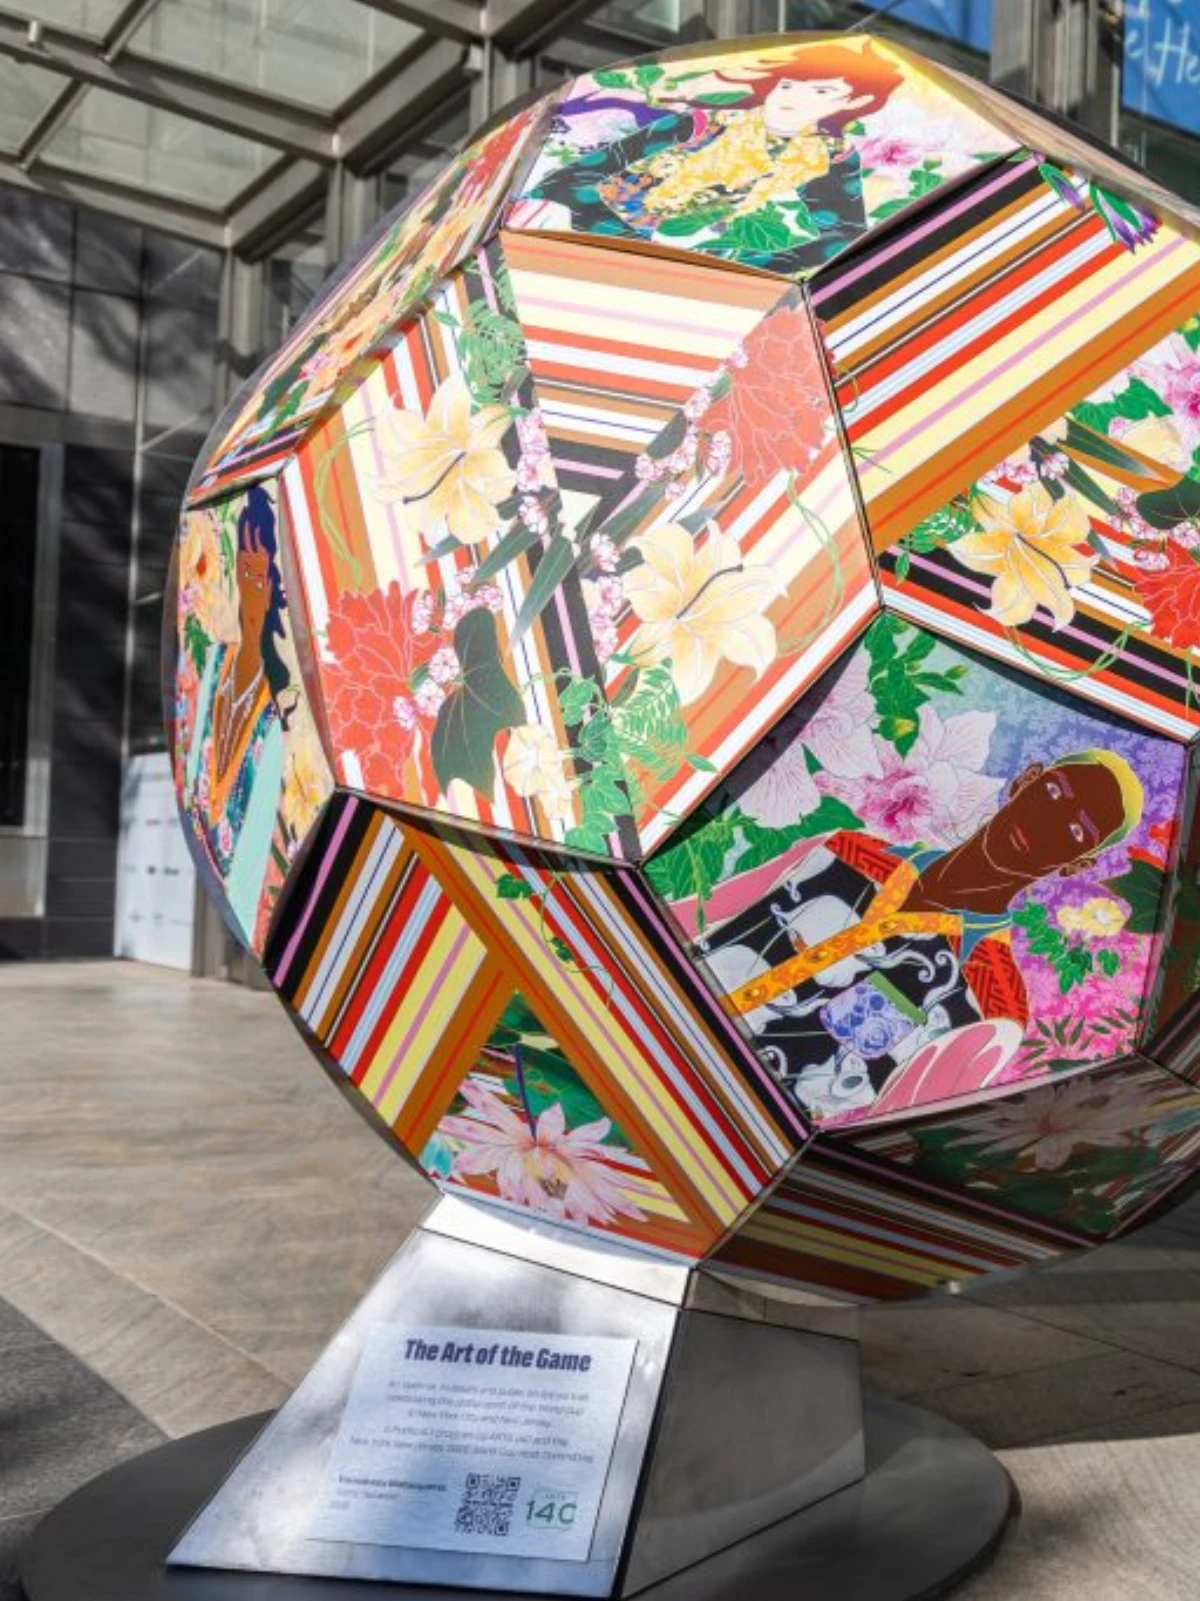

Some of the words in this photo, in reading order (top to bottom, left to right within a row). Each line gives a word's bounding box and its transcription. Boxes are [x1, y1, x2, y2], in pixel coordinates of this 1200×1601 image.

[404, 1338, 439, 1361] The
[440, 1341, 475, 1364] Art
[475, 1343, 500, 1366] of
[500, 1346, 535, 1368] the
[536, 1348, 592, 1373] Game
[525, 1500, 577, 1526] 14C
